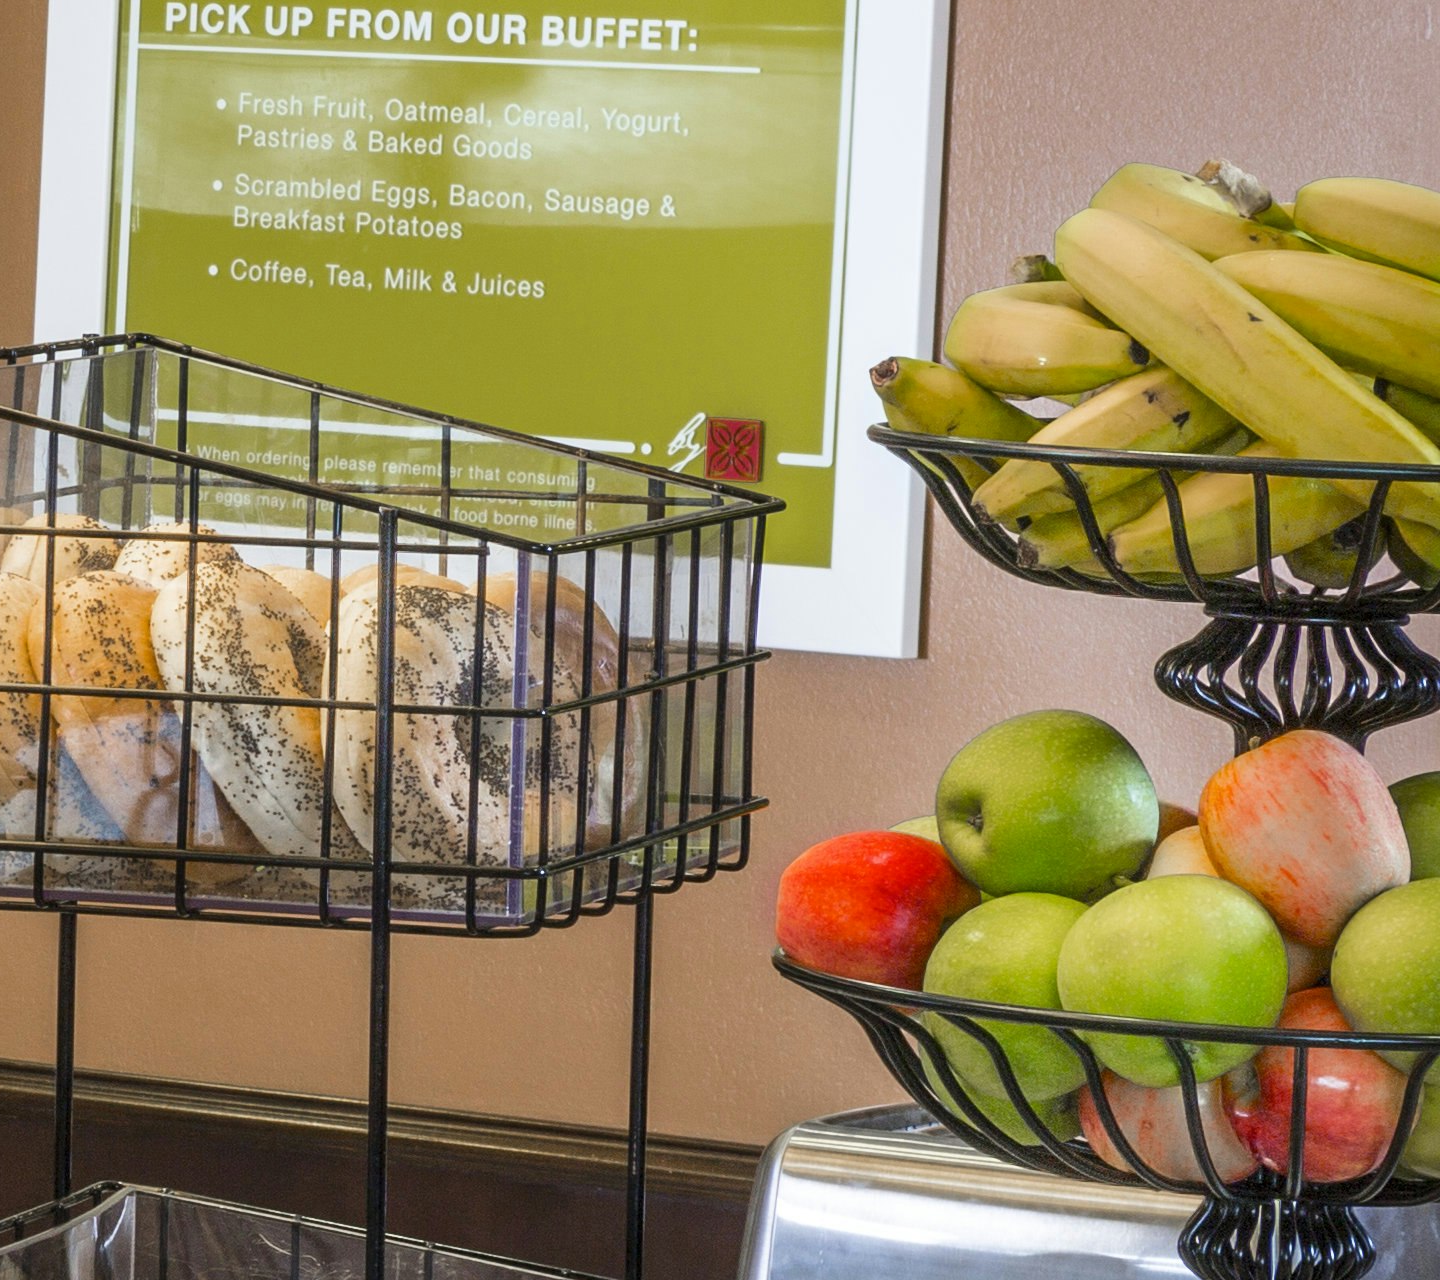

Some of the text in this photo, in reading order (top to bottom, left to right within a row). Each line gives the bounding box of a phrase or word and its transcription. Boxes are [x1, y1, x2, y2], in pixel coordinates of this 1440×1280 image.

[165, 1, 698, 52] PICK UP FROM OUR BUFFET:
[237, 90, 689, 138] Fresh Fruit, Oatmeal, Cereal, Yogurt,
[237, 123, 532, 161] Pastries & Baked Goods
[234, 172, 676, 219] Scrambled Eggs, Bacon, Sausage &
[232, 204, 463, 240] Breakfast Potatoes
[229, 257, 545, 299] Coffee, Tea, Milk & Juices
[197, 444, 240, 462] When
[324, 456, 377, 471] please
[468, 466, 501, 482] that
[506, 471, 596, 491] consumig
[215, 492, 598, 531] eggs may food borne illnes.
